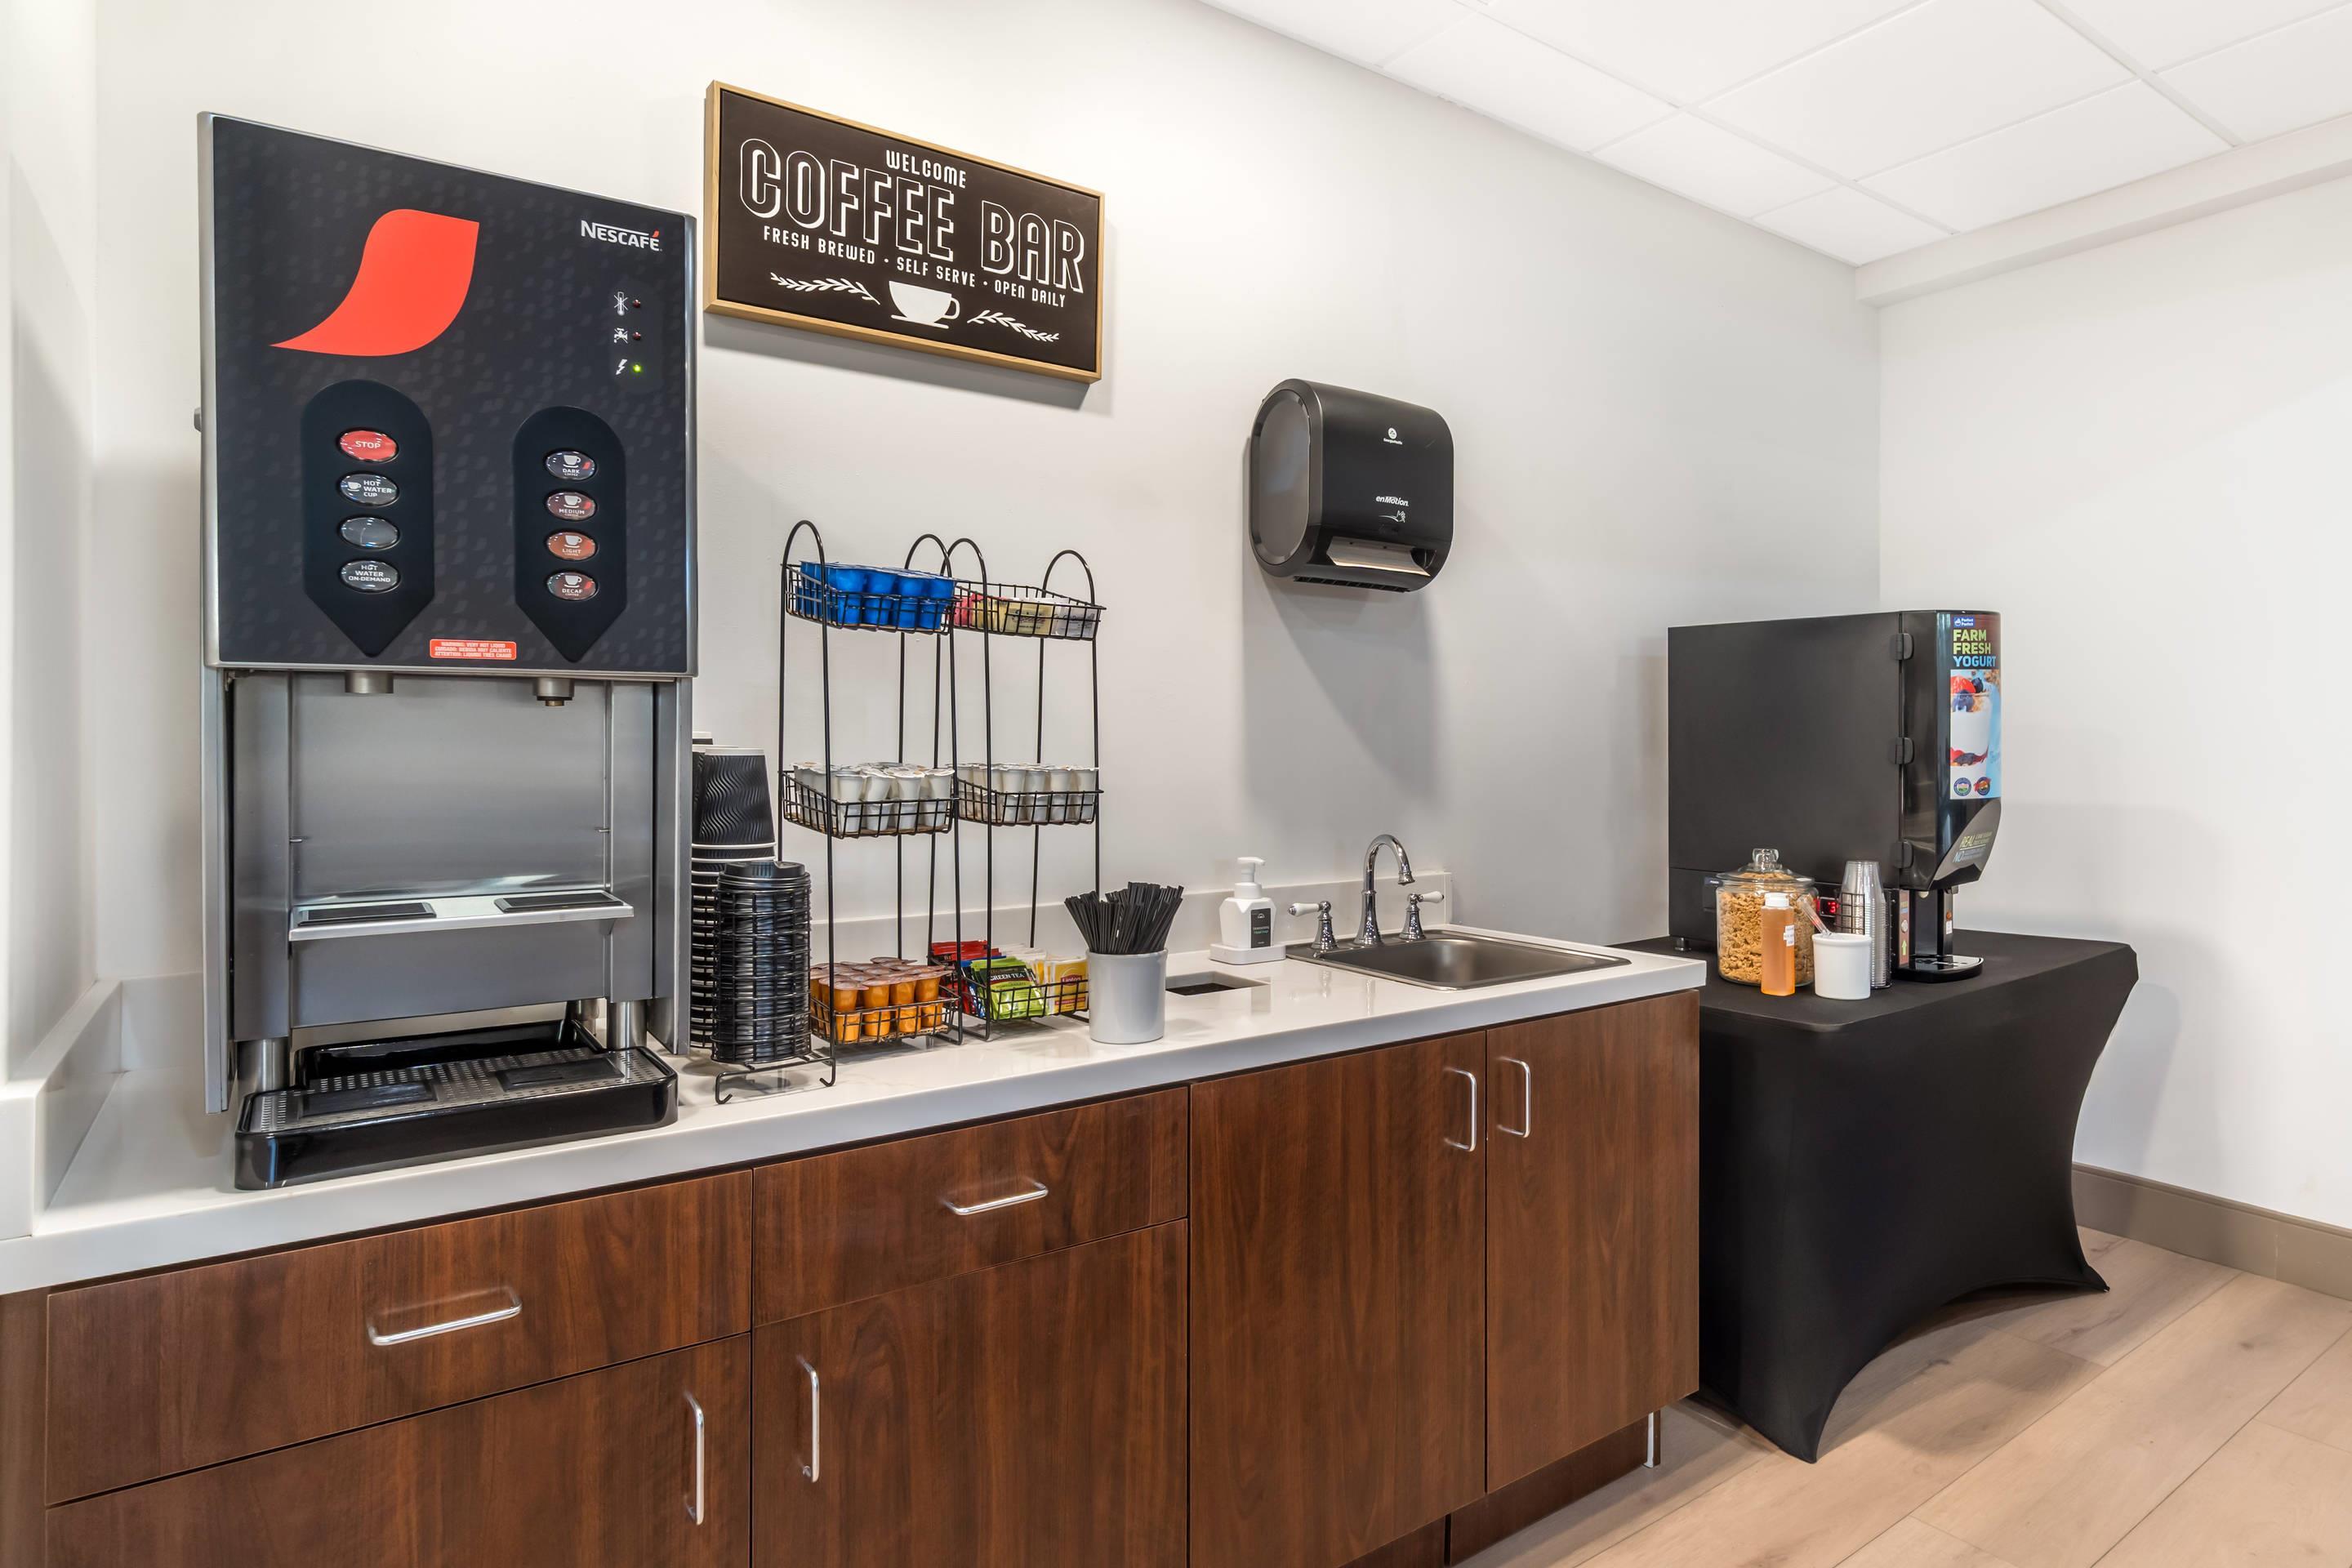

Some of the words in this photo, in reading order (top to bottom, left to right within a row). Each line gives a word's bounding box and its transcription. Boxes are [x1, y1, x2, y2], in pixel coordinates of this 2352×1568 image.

[885, 149, 968, 189] WELCOME
[739, 138, 956, 262] COFFEE
[980, 199, 1085, 295] BAR
[580, 220, 660, 252] NESCAFÉ
[763, 225, 810, 251] FRESH
[817, 238, 875, 265] BREWED
[896, 256, 929, 277] SELF
[935, 265, 977, 287] SERVE
[994, 279, 1026, 300] OPEN
[1031, 287, 1066, 308] DAILY
[354, 440, 381, 449] STOP
[363, 486, 393, 494] WATER
[1375, 496, 1409, 506] enMotion
[1953, 629, 1987, 641] FARM
[1953, 642, 1991, 654] FRESH
[1953, 656, 1996, 667] YOGURT
